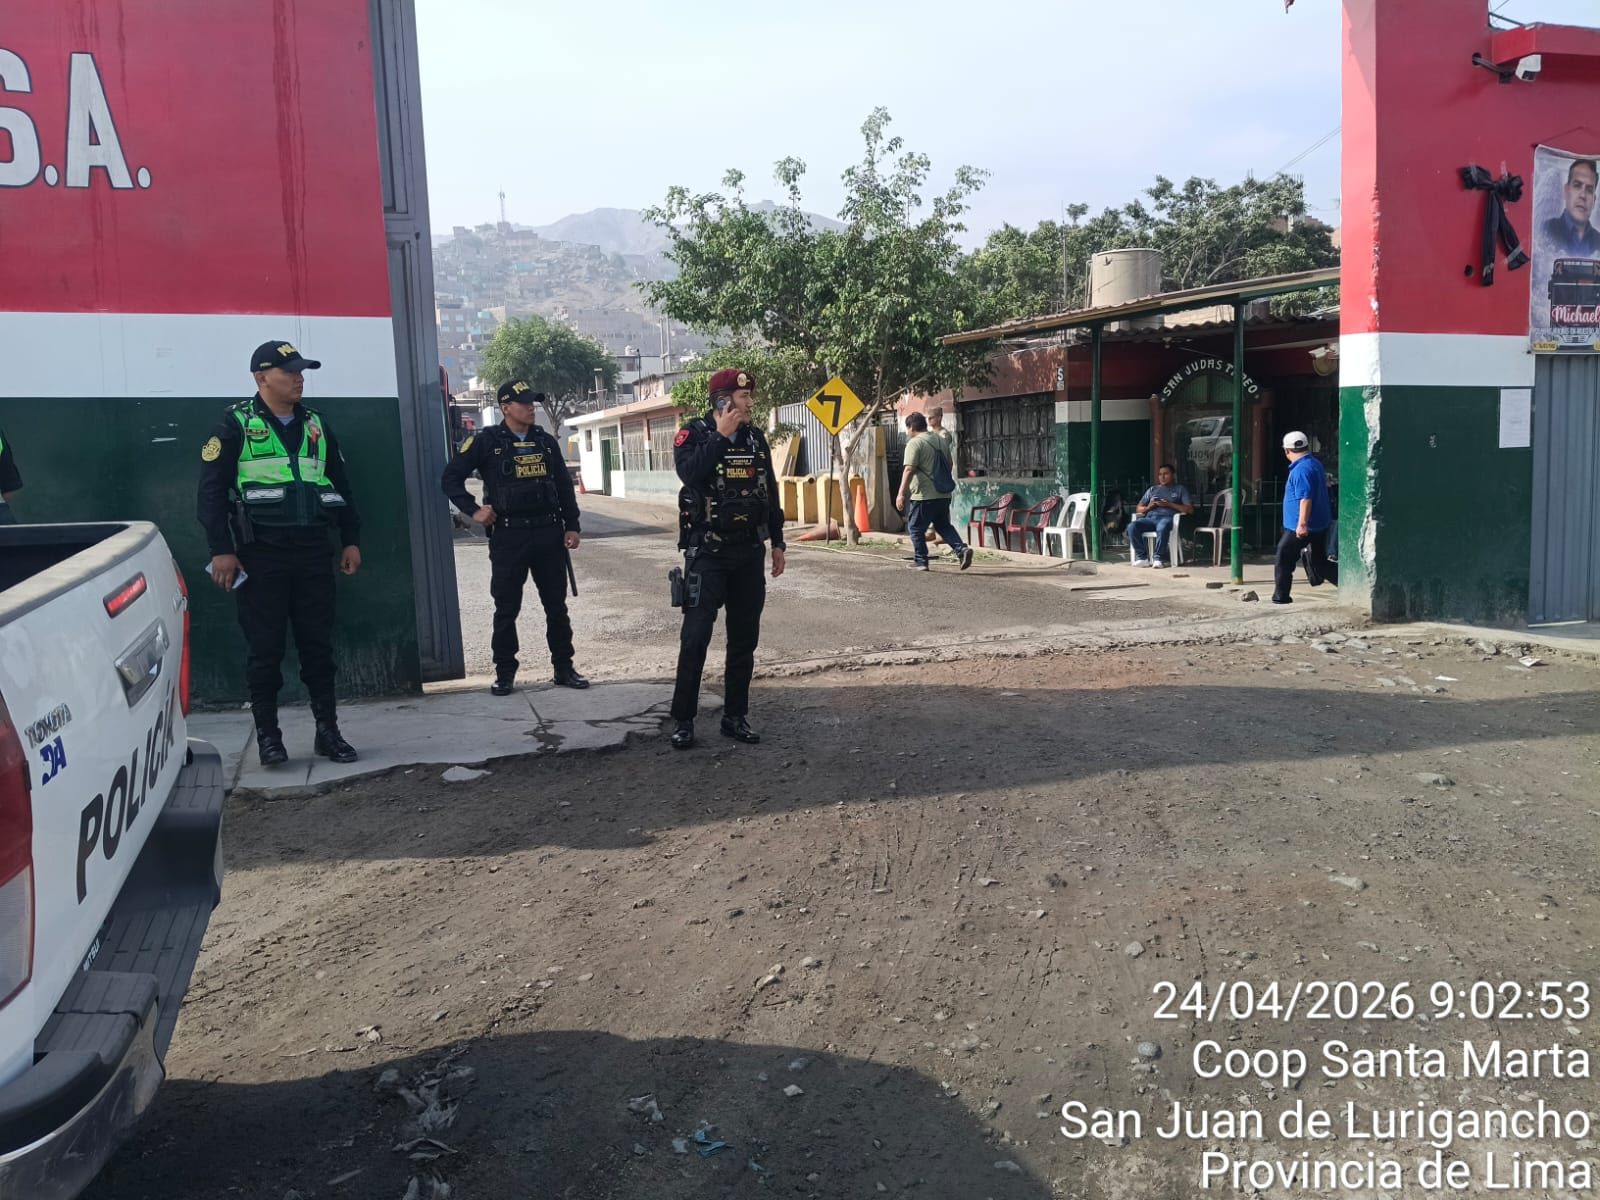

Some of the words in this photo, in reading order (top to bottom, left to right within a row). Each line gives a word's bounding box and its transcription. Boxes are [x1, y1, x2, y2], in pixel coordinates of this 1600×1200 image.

[1162, 372, 1183, 397] SAN
[1185, 359, 1223, 375] JUDAS
[24, 702, 72, 749] TOYOTA
